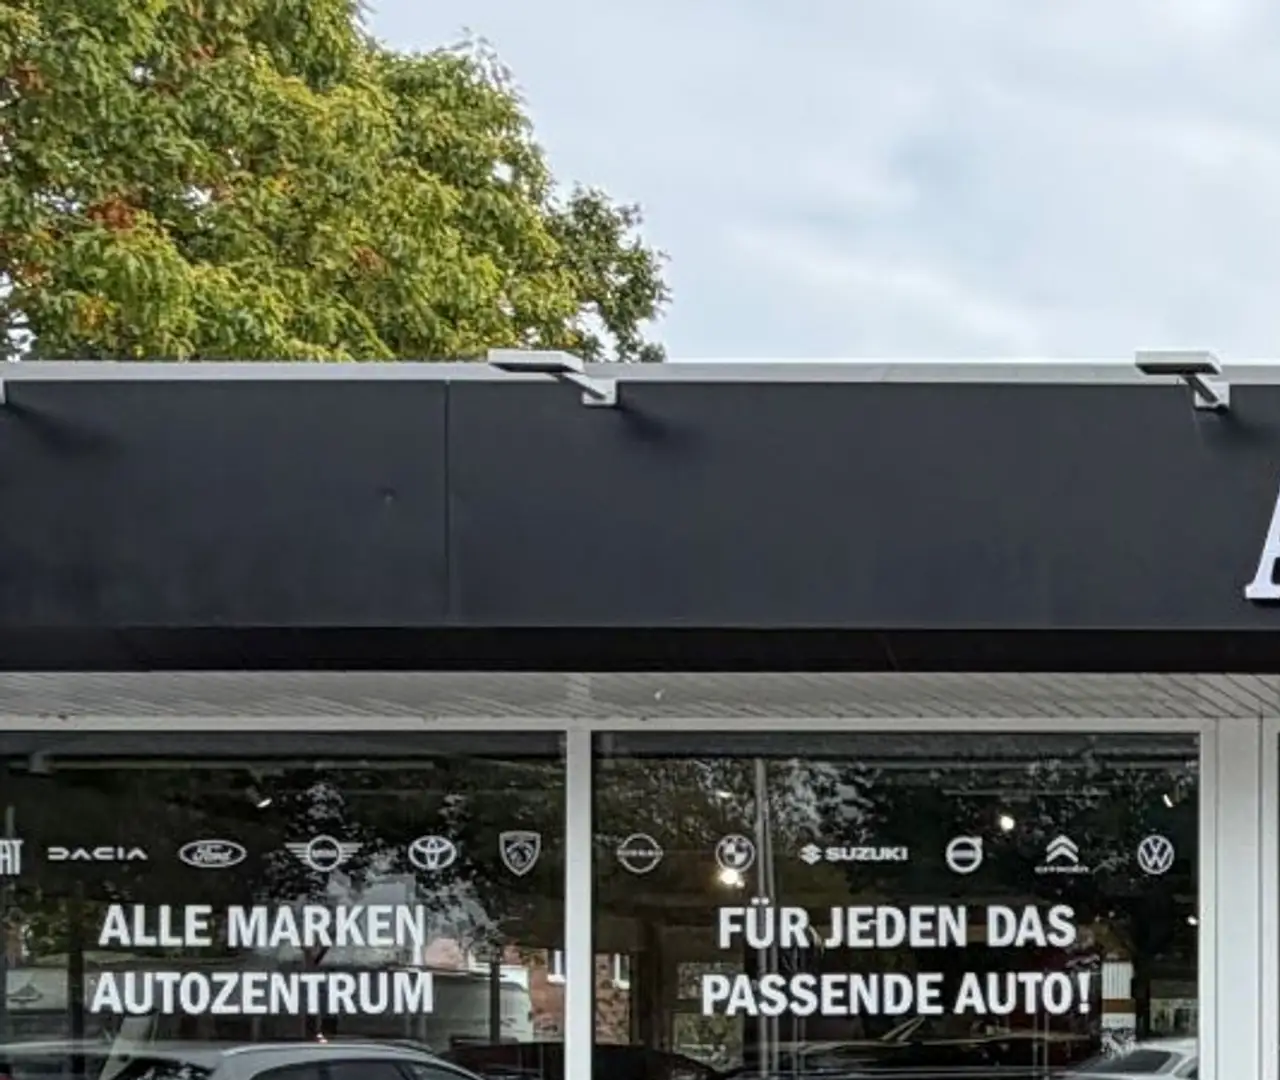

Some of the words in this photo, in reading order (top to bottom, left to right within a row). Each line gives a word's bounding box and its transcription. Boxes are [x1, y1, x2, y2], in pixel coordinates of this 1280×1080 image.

[0, 839, 23, 875] AT
[48, 846, 148, 861] DACIA
[825, 846, 908, 861] SUZUKI
[99, 905, 211, 946] ALLE
[228, 905, 425, 948] MARKEN
[718, 897, 811, 949] FÜR
[824, 906, 967, 948] JEDEN
[988, 905, 1077, 947] DAS
[91, 972, 433, 1014] AUTOZENTRUM
[702, 973, 943, 1016] PASSENDE
[954, 972, 1091, 1014] AUTO!
